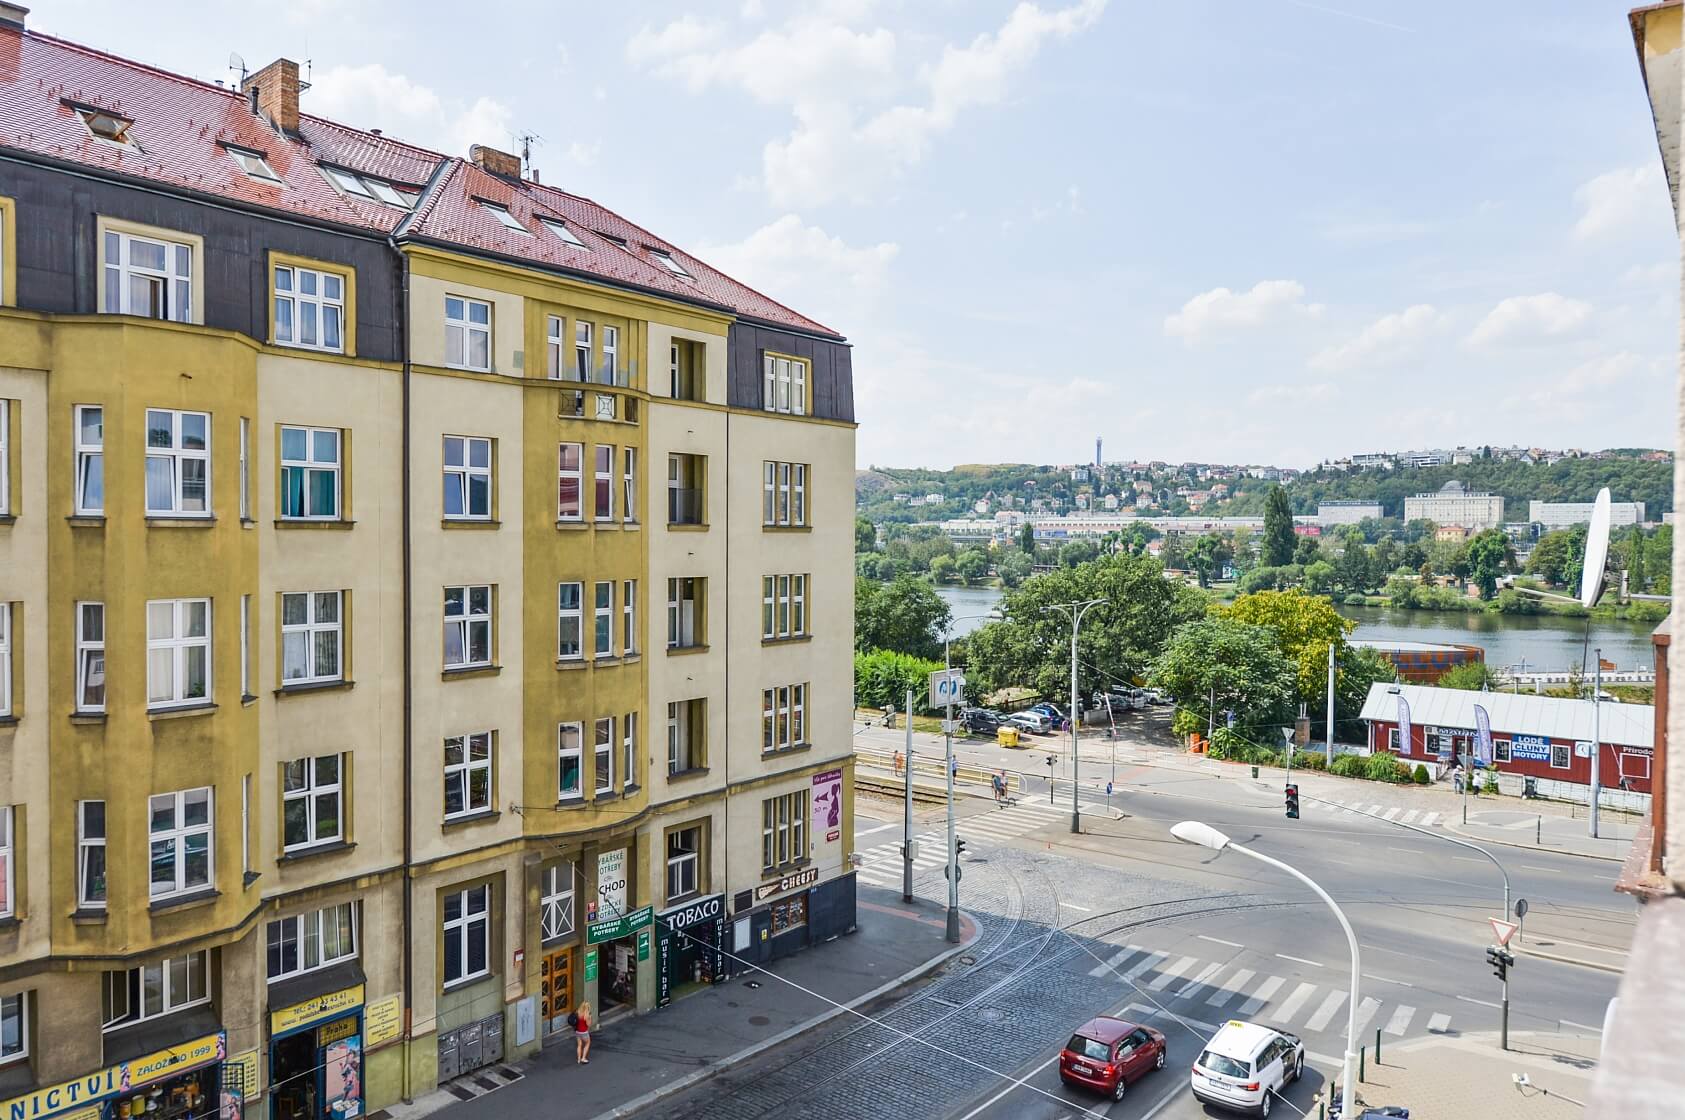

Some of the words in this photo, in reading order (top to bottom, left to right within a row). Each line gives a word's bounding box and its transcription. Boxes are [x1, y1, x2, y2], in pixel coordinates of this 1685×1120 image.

[1513, 750, 1548, 760] MOTORY
[782, 869, 816, 890] CHEESY
[599, 880, 626, 895] CHOD
[191, 1045, 211, 1059] 1999
